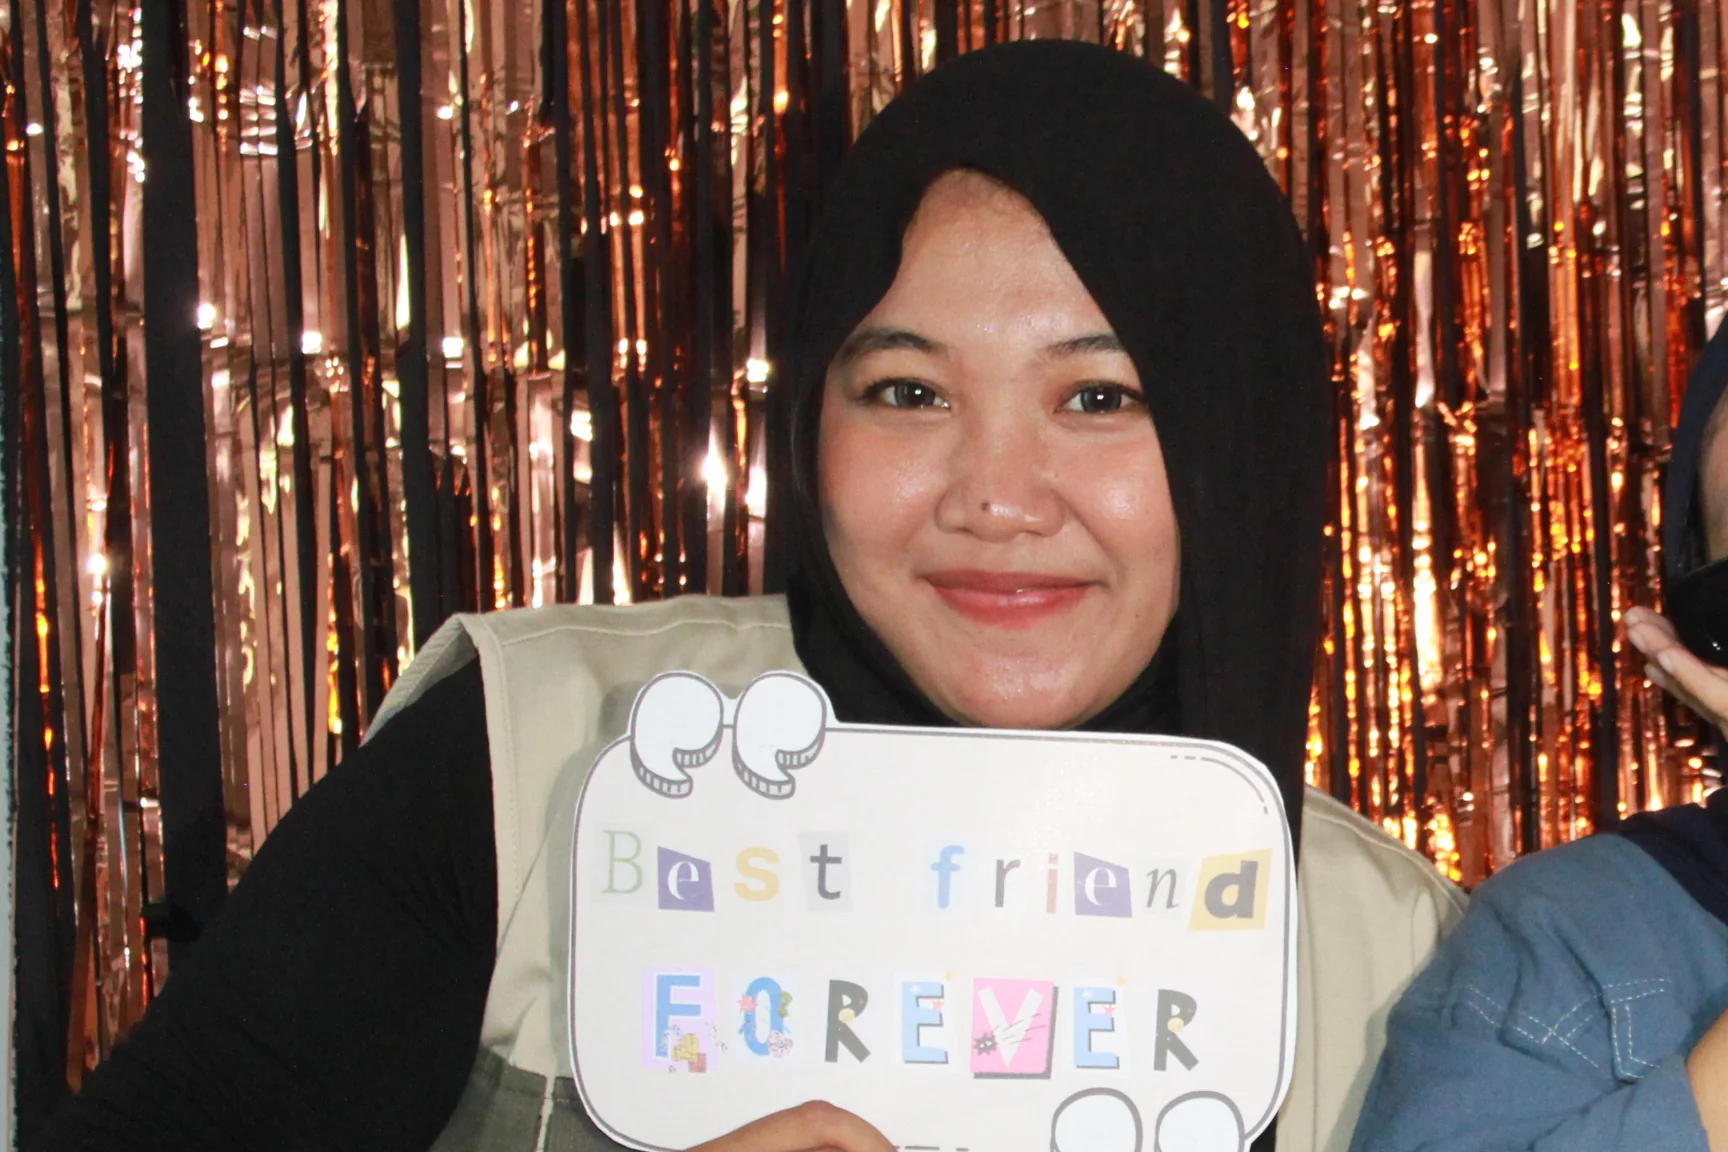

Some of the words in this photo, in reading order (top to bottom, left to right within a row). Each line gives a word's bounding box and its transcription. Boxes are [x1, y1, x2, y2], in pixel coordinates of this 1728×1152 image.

[600, 829, 844, 904] Best
[929, 844, 1260, 920] friend
[652, 973, 1200, 1073] FOREVER
